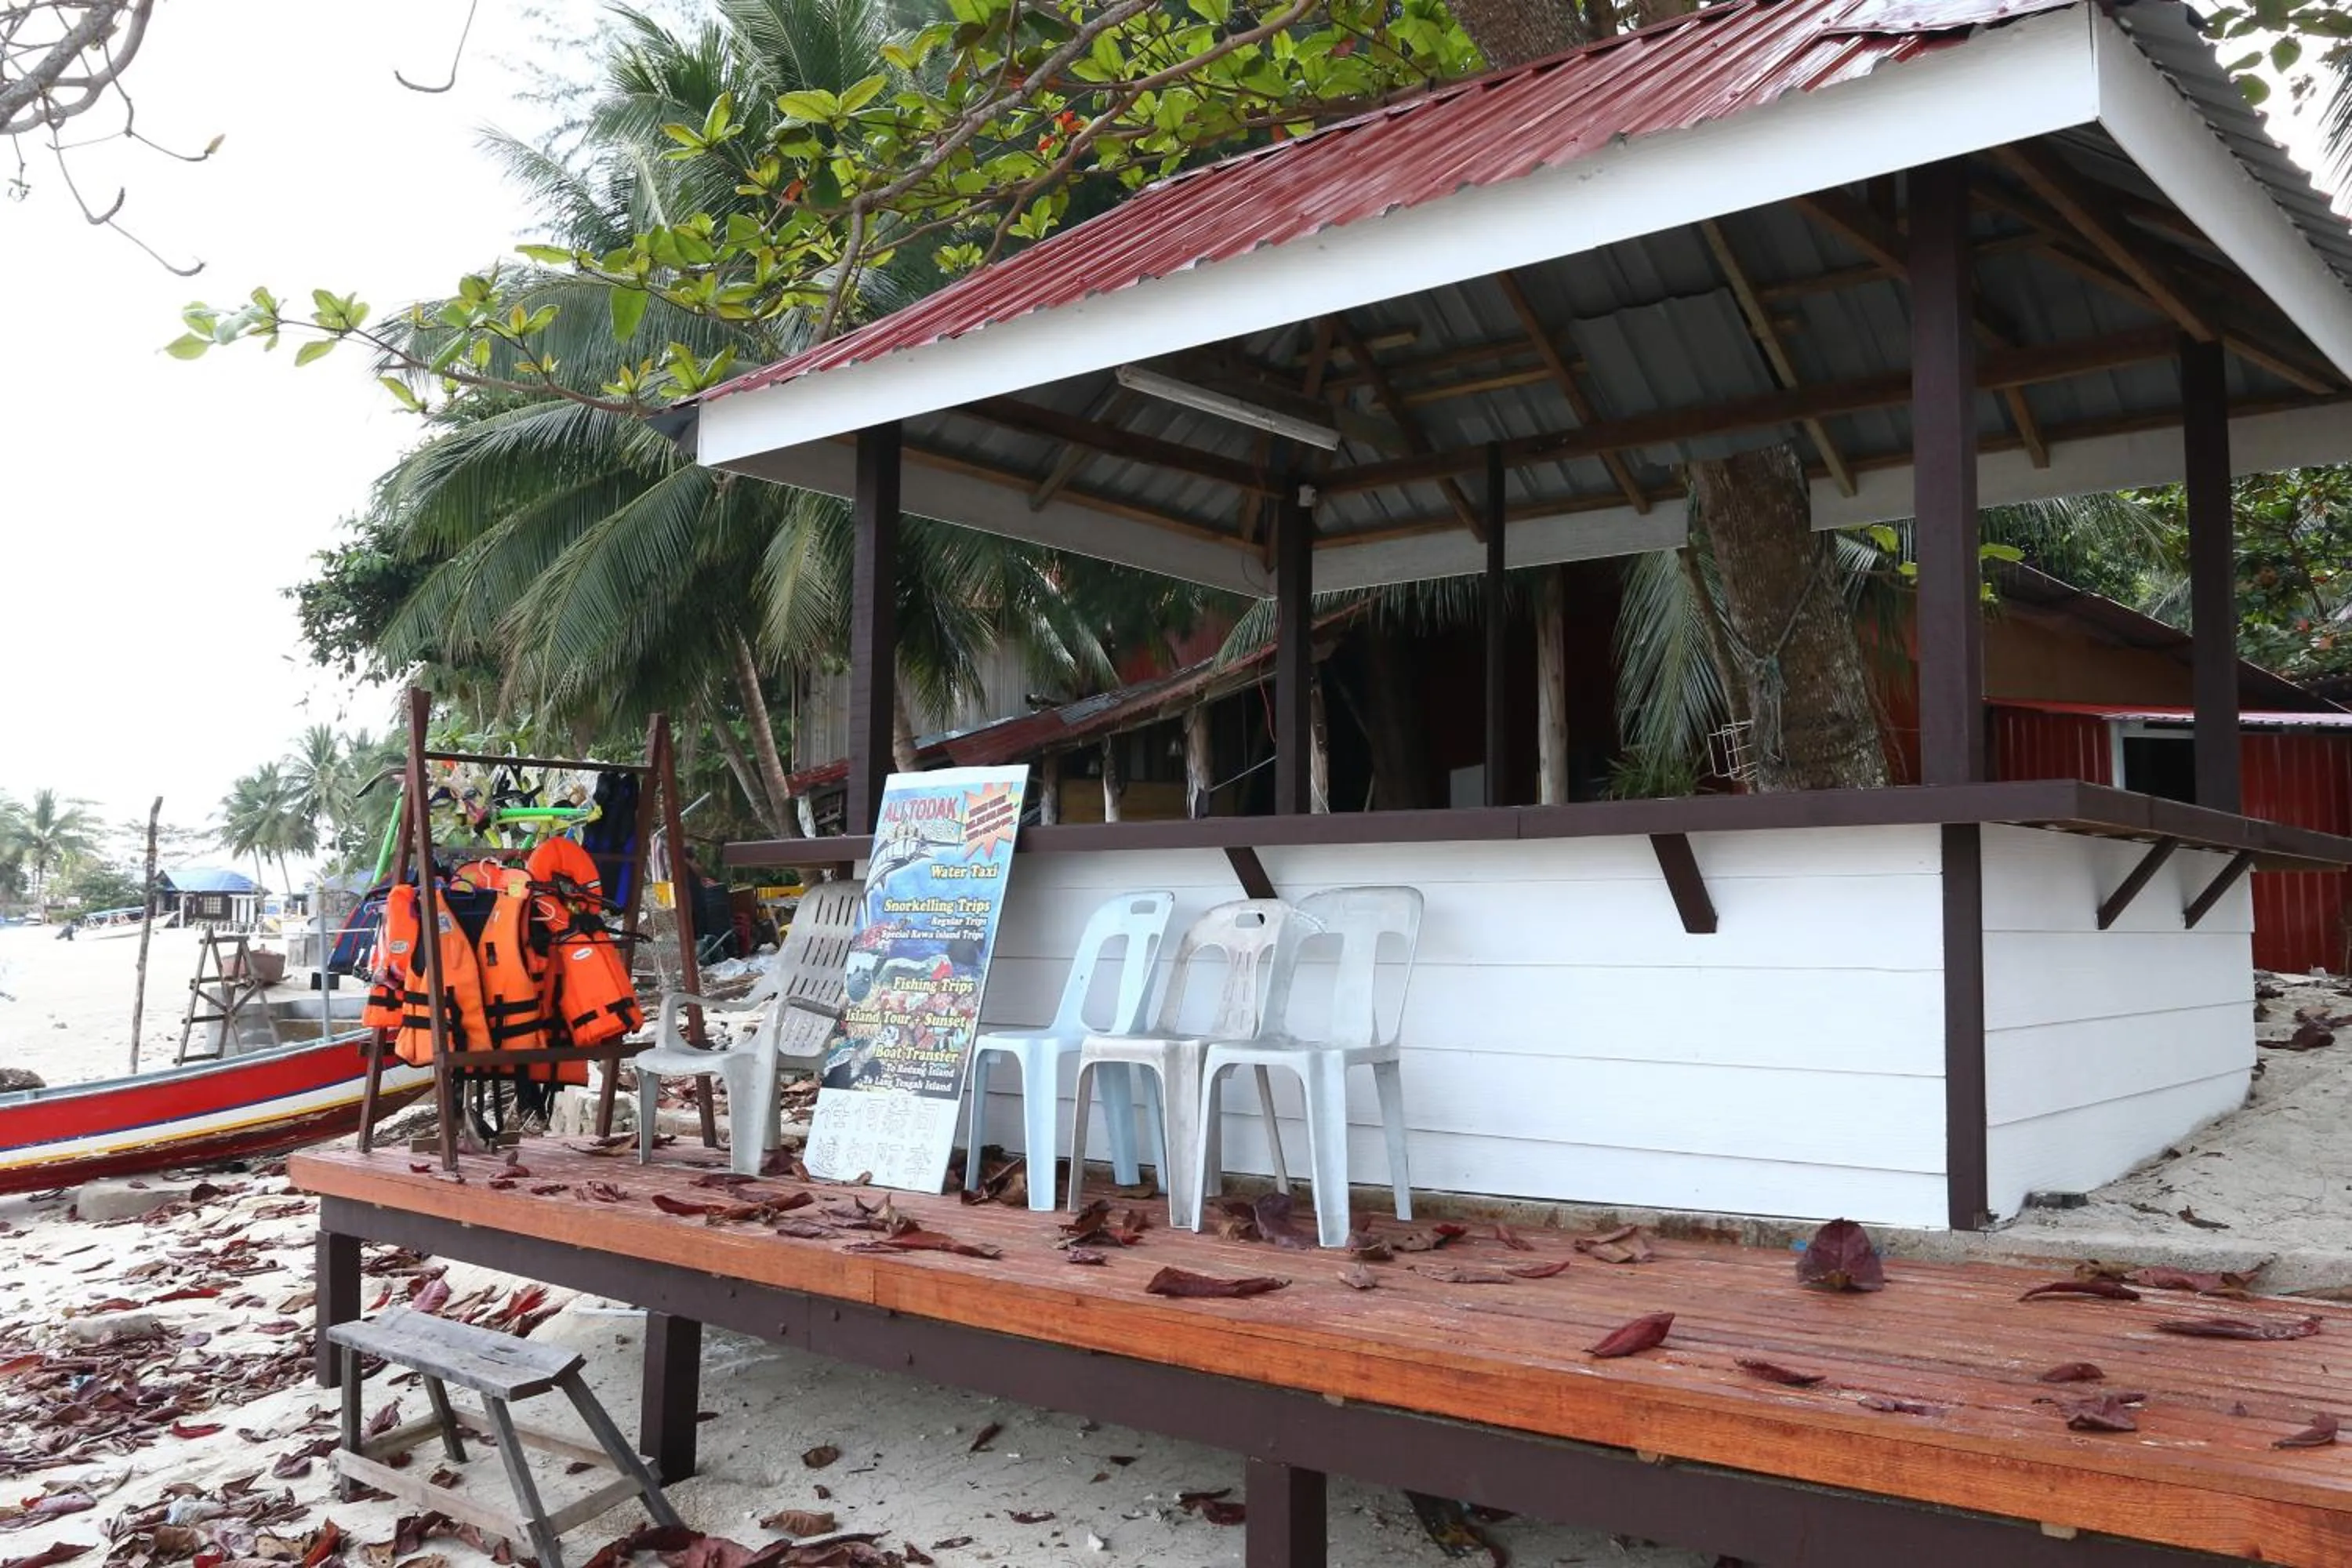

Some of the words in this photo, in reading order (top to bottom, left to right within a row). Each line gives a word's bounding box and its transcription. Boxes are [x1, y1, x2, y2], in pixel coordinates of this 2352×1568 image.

[906, 796, 958, 819] TODAK
[931, 864, 967, 879] Water
[971, 862, 999, 878] Taxi
[884, 898, 954, 914] Snorkelling
[957, 898, 991, 913] Trips
[964, 918, 987, 927] Trips
[881, 930, 910, 939] Special
[963, 931, 985, 941] Trips
[893, 977, 939, 994] Fishing
[941, 979, 975, 994] Trips
[846, 1009, 880, 1023] Island
[884, 1011, 912, 1024] Tour
[924, 1013, 967, 1027] Sunset
[876, 1044, 903, 1058] Boat
[906, 1046, 959, 1062] Transfer
[887, 1062, 896, 1072] To
[927, 1065, 955, 1078] Island
[924, 1080, 952, 1092] Island
